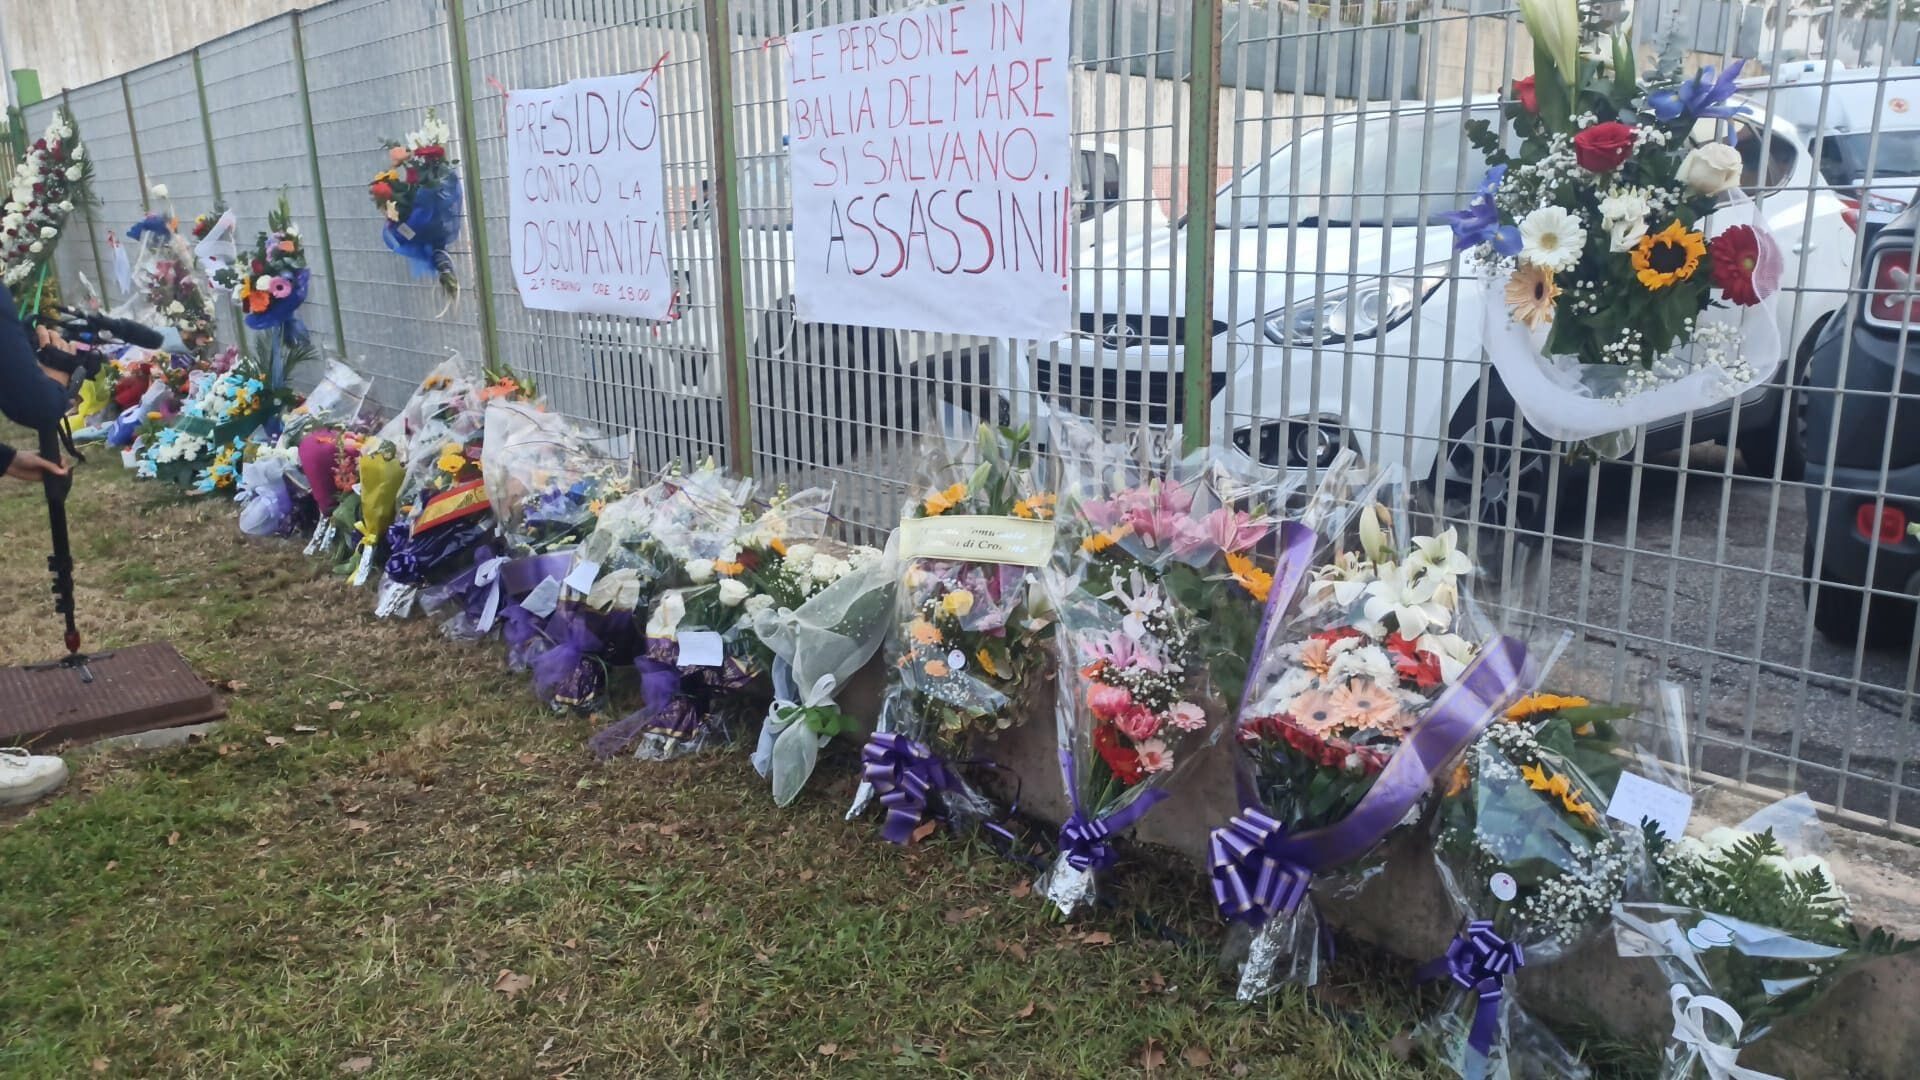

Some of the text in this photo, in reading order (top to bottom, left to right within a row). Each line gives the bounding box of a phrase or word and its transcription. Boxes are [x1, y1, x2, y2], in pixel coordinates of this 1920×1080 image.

[789, 0, 1025, 84] LE PERSONE IN
[795, 57, 1055, 140] BALIA DEL MARE
[813, 127, 1049, 186] SI SALVANO.
[523, 162, 643, 204] CONTRO LA
[592, 282, 612, 296] ORE
[962, 539, 974, 549] di
